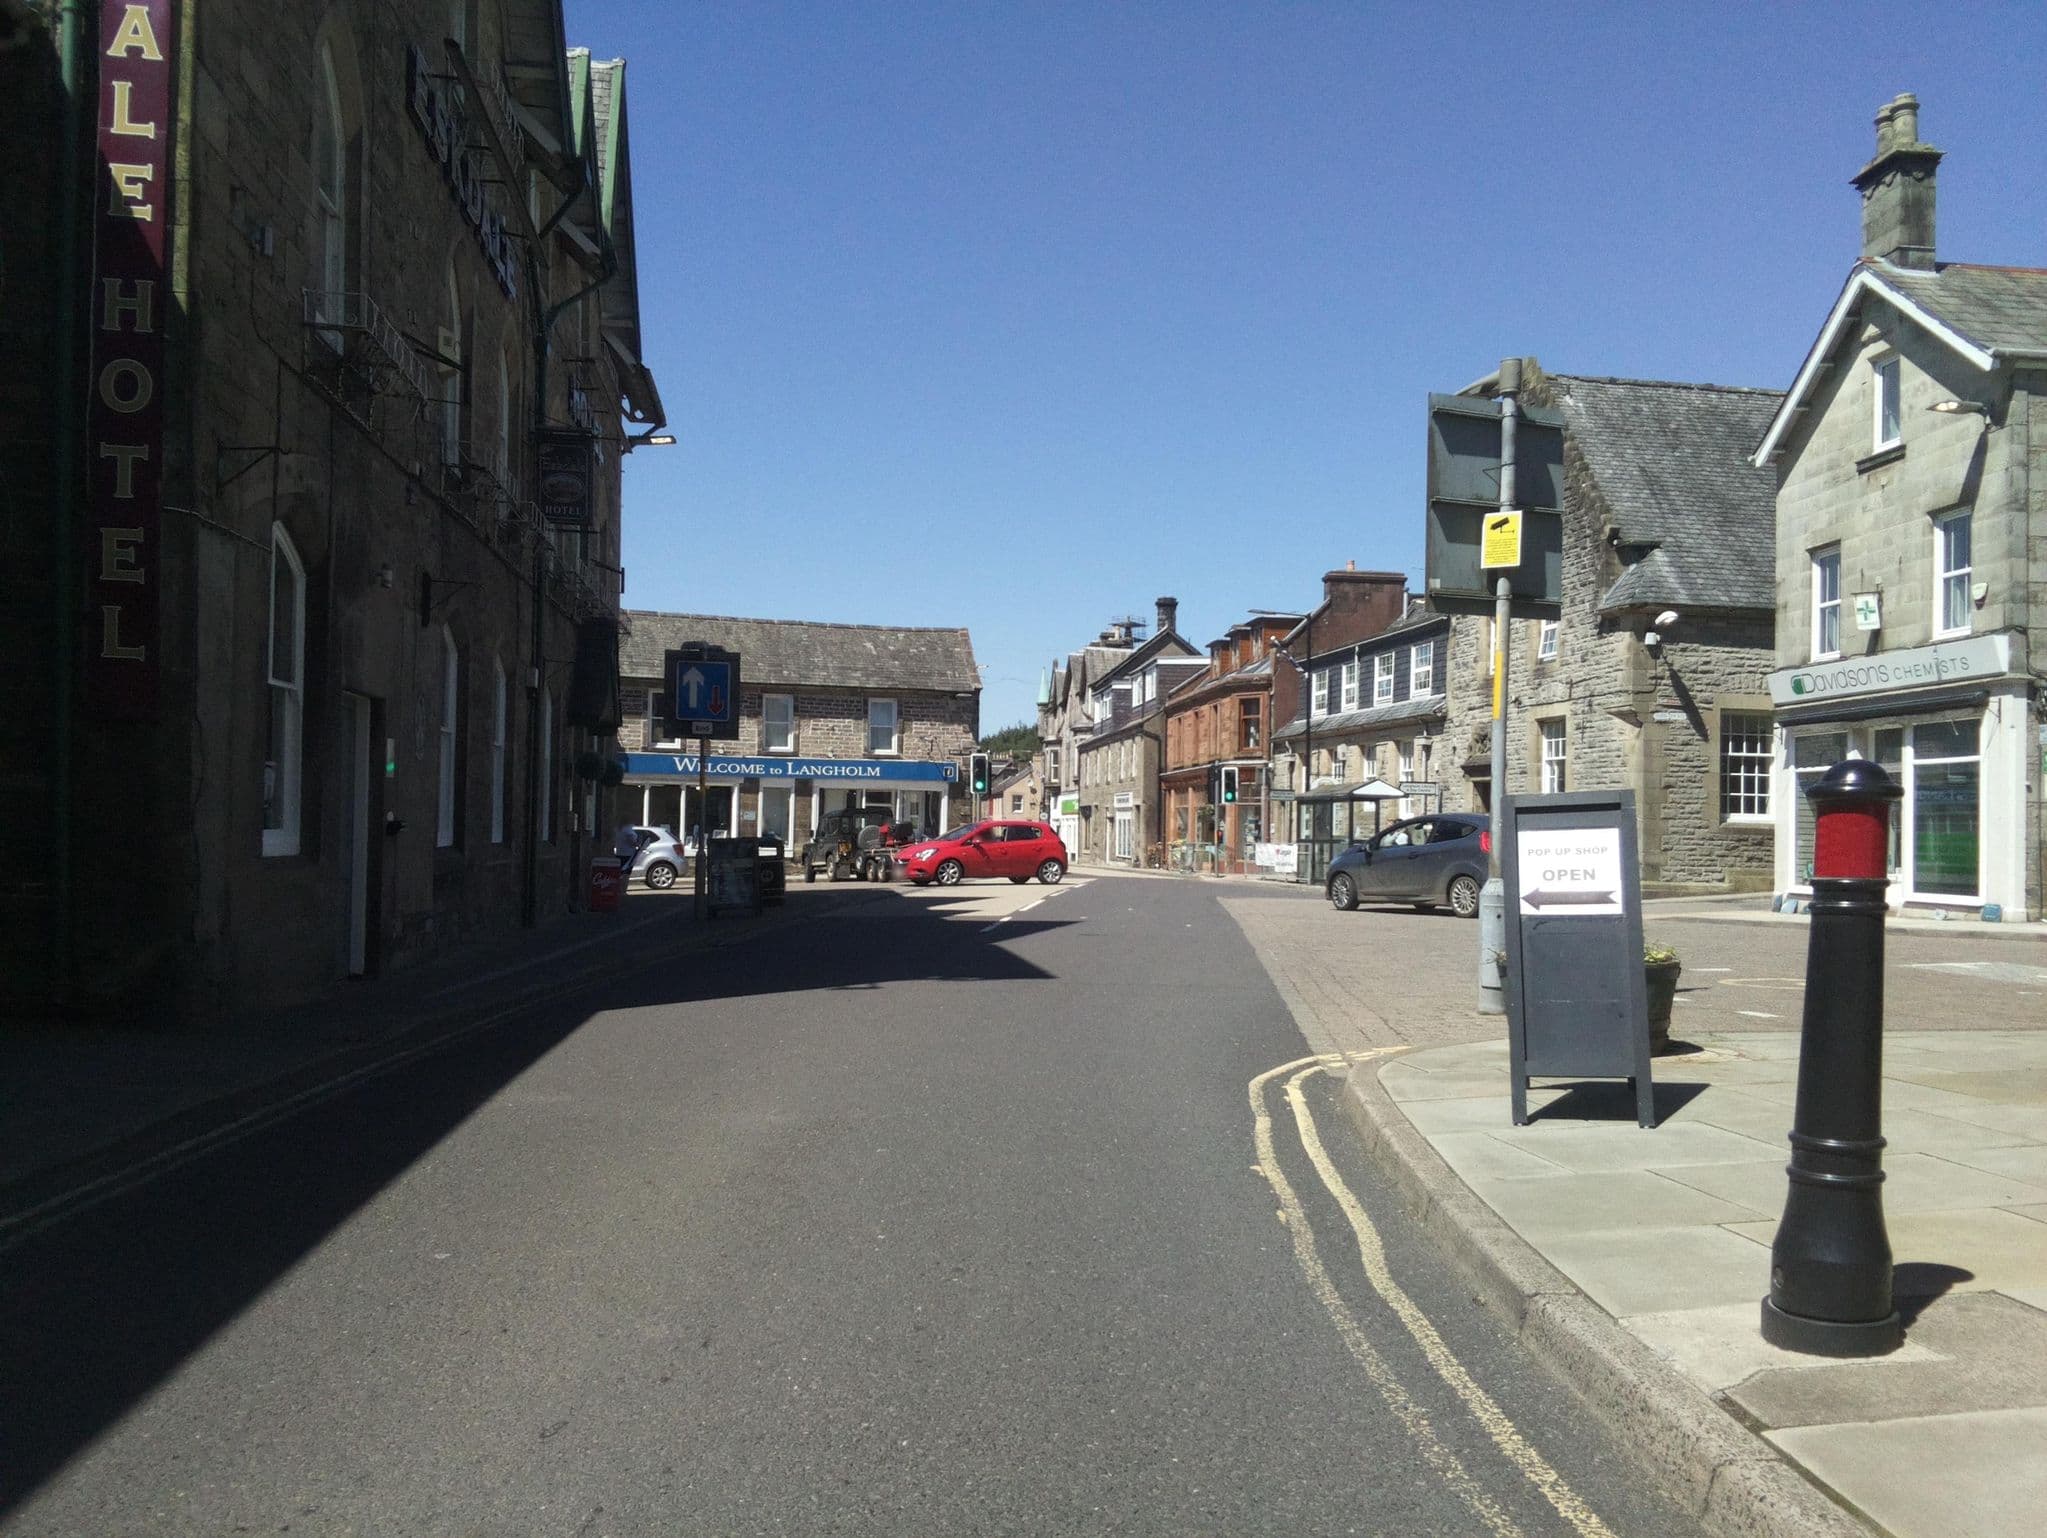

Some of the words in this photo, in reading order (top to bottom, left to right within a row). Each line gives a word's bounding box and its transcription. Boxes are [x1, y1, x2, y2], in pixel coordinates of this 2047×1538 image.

[99, 277, 154, 662] HOTEL
[1798, 664, 1889, 694] Davidsons
[1893, 655, 1970, 682] CHEMISTS
[770, 767, 782, 775] to
[787, 761, 880, 777] LANGHOLM
[1528, 848, 1551, 857] POP
[1555, 847, 1571, 856] UP
[1575, 846, 1608, 856] SHOP
[1543, 868, 1595, 882] OPEN
